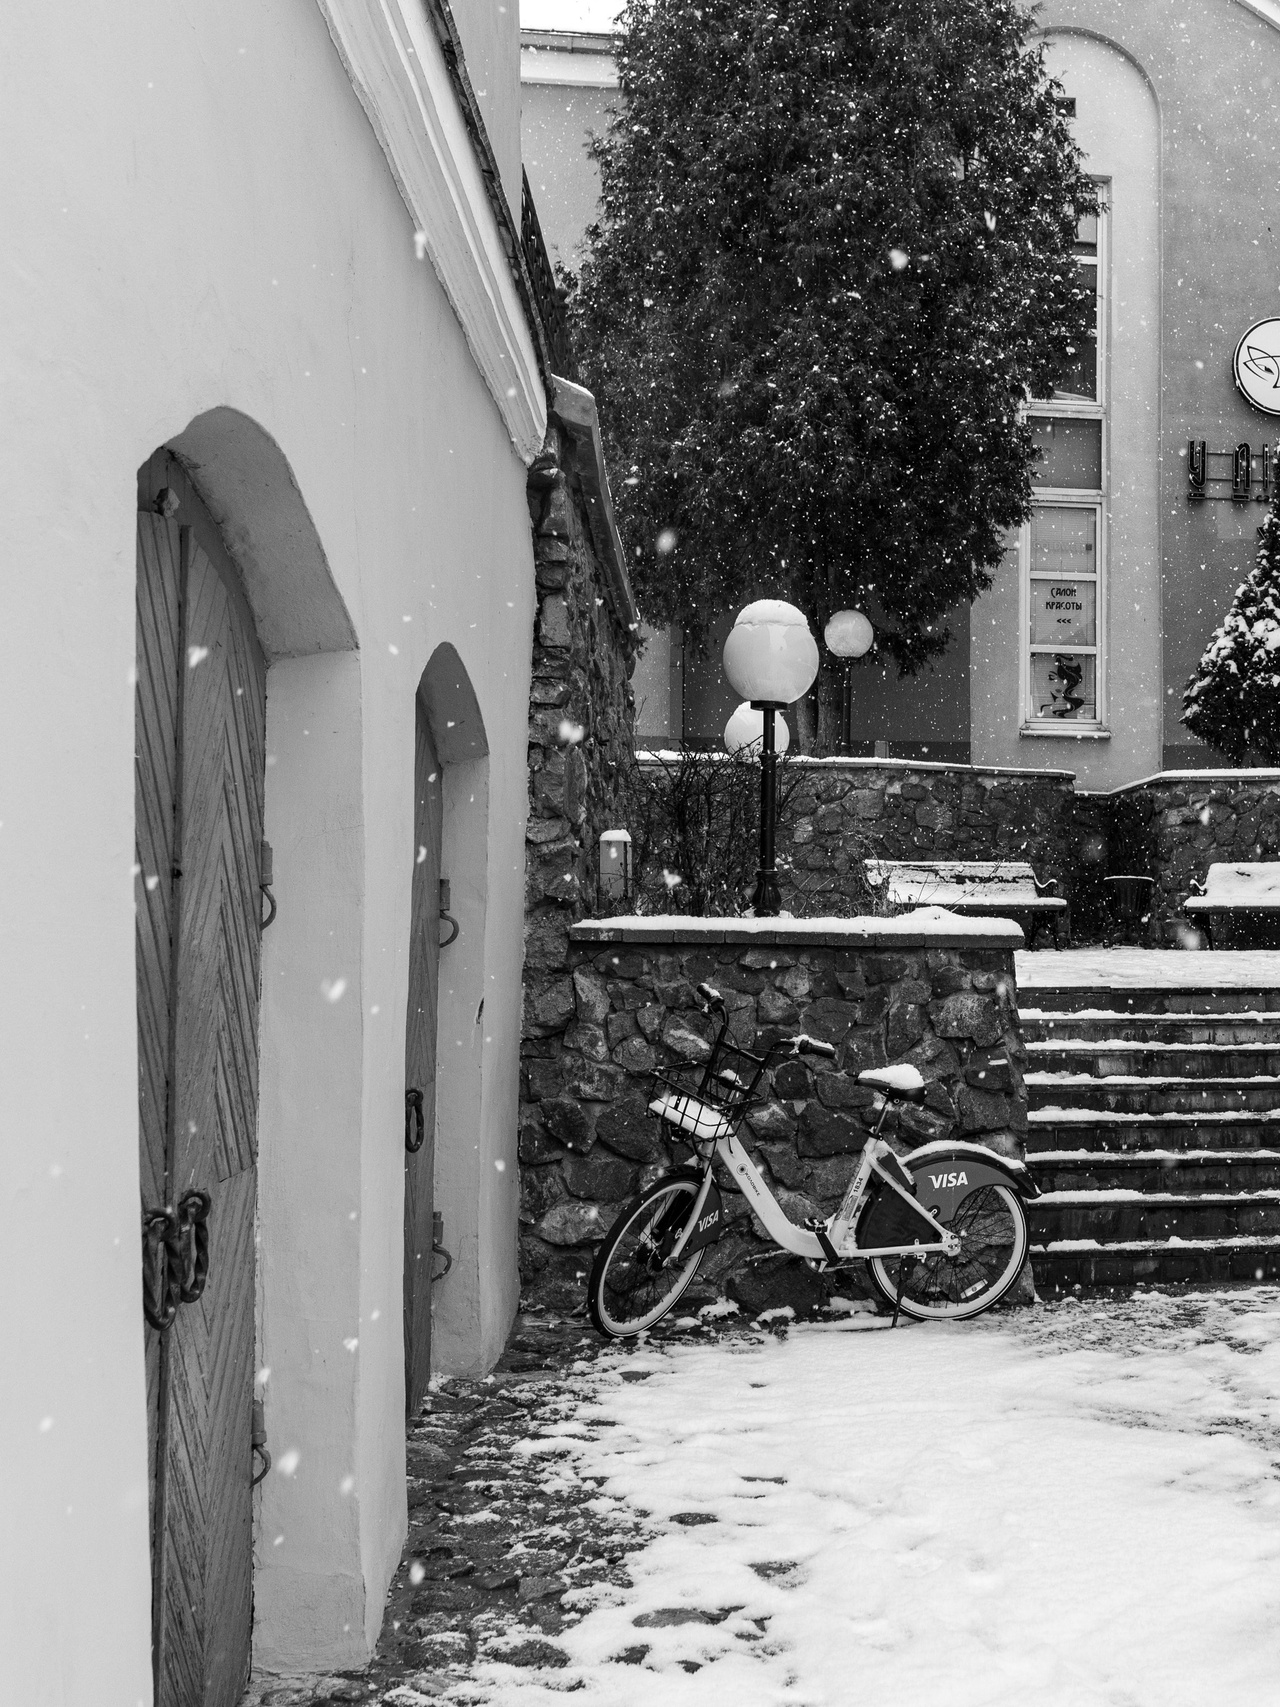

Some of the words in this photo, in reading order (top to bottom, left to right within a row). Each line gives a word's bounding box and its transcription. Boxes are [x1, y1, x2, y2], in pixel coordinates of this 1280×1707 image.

[1050, 587, 1077, 599] САЛОН
[1045, 601, 1082, 611] КРАСОТЫ
[853, 1177, 864, 1193] 1834
[927, 1171, 969, 1189] VISA
[697, 1209, 719, 1233] VISA
